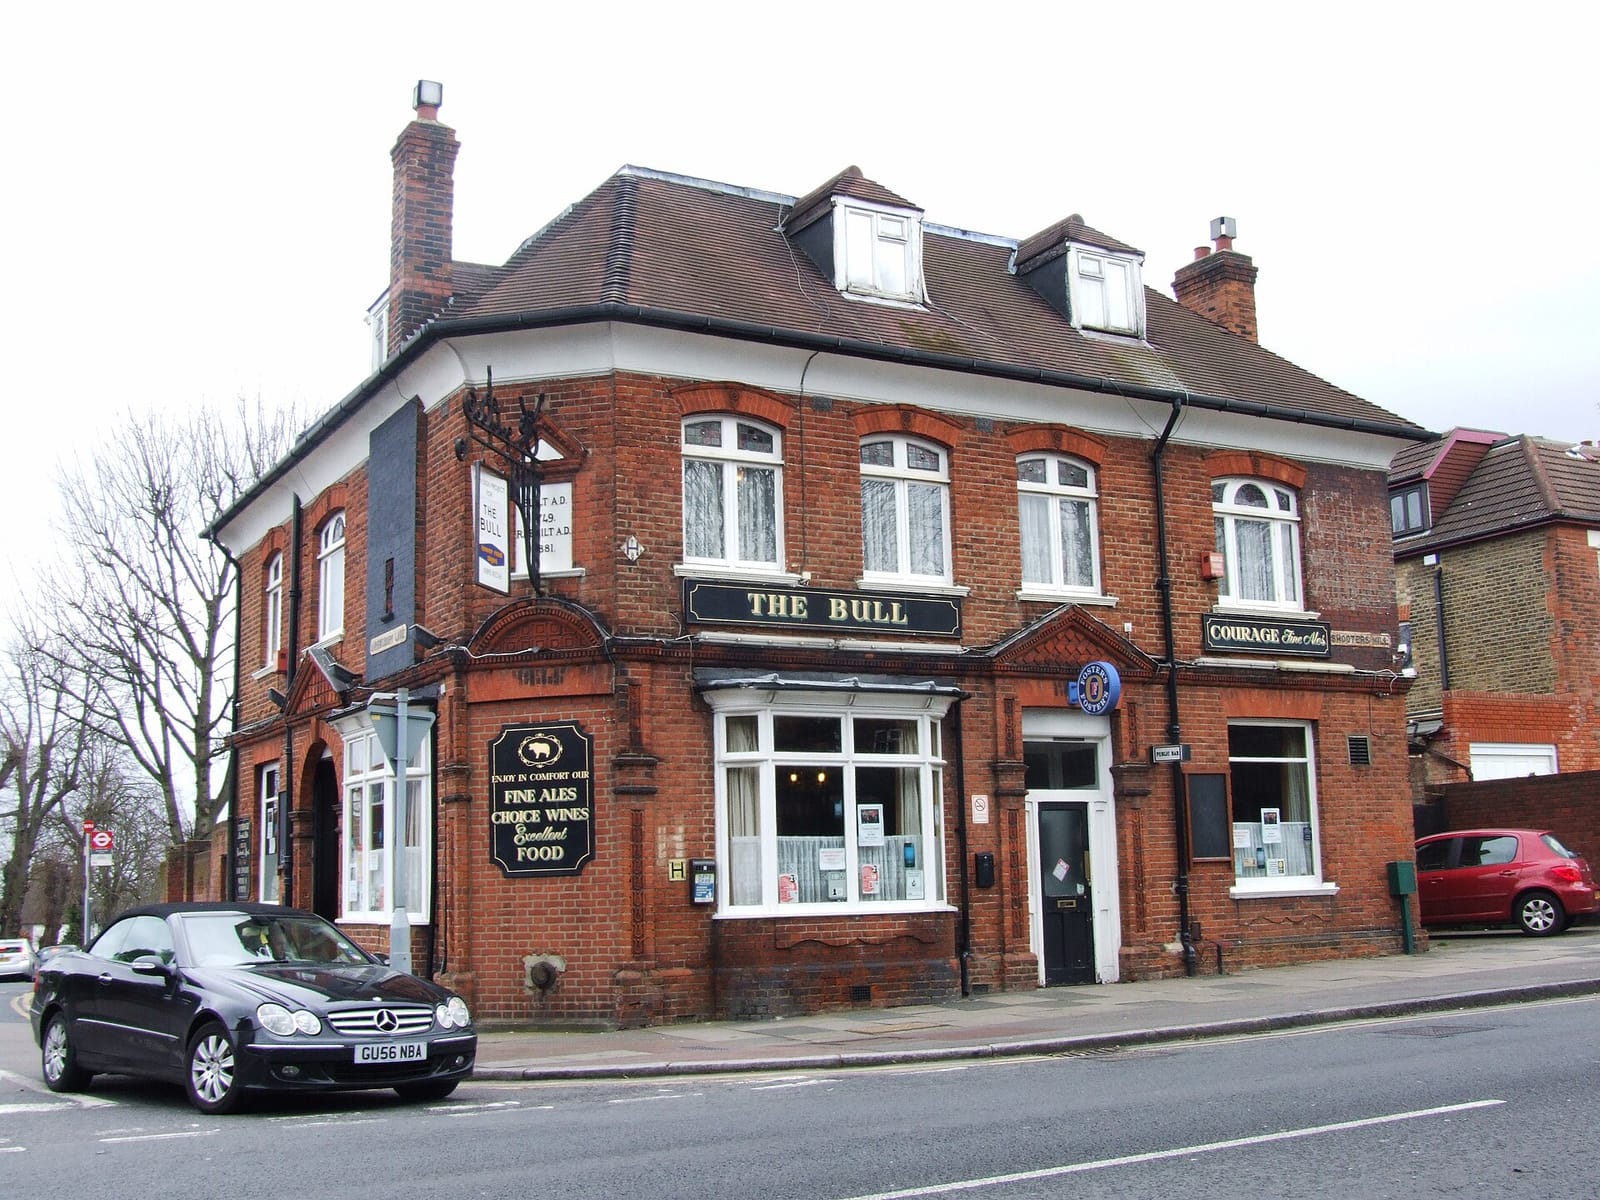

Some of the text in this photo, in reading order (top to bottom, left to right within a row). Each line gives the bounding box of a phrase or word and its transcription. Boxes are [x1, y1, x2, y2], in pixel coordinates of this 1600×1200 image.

[483, 504, 496, 520] THE
[480, 518, 502, 538] BULL
[748, 593, 908, 626] THE BULL
[1210, 624, 1326, 646] COURAGE Fine Ales
[1331, 634, 1370, 645] SHOOTERS
[1080, 665, 1109, 685] FOSTER'S
[491, 770, 590, 783] ENJOY IN COMFORT OUR
[504, 787, 577, 804] FINE ALES
[491, 807, 590, 825] CHOICE WINES
[513, 823, 568, 846] Excellent
[517, 845, 565, 862] FOOD
[671, 861, 684, 879] H
[361, 1044, 422, 1060] GU56 NBA
